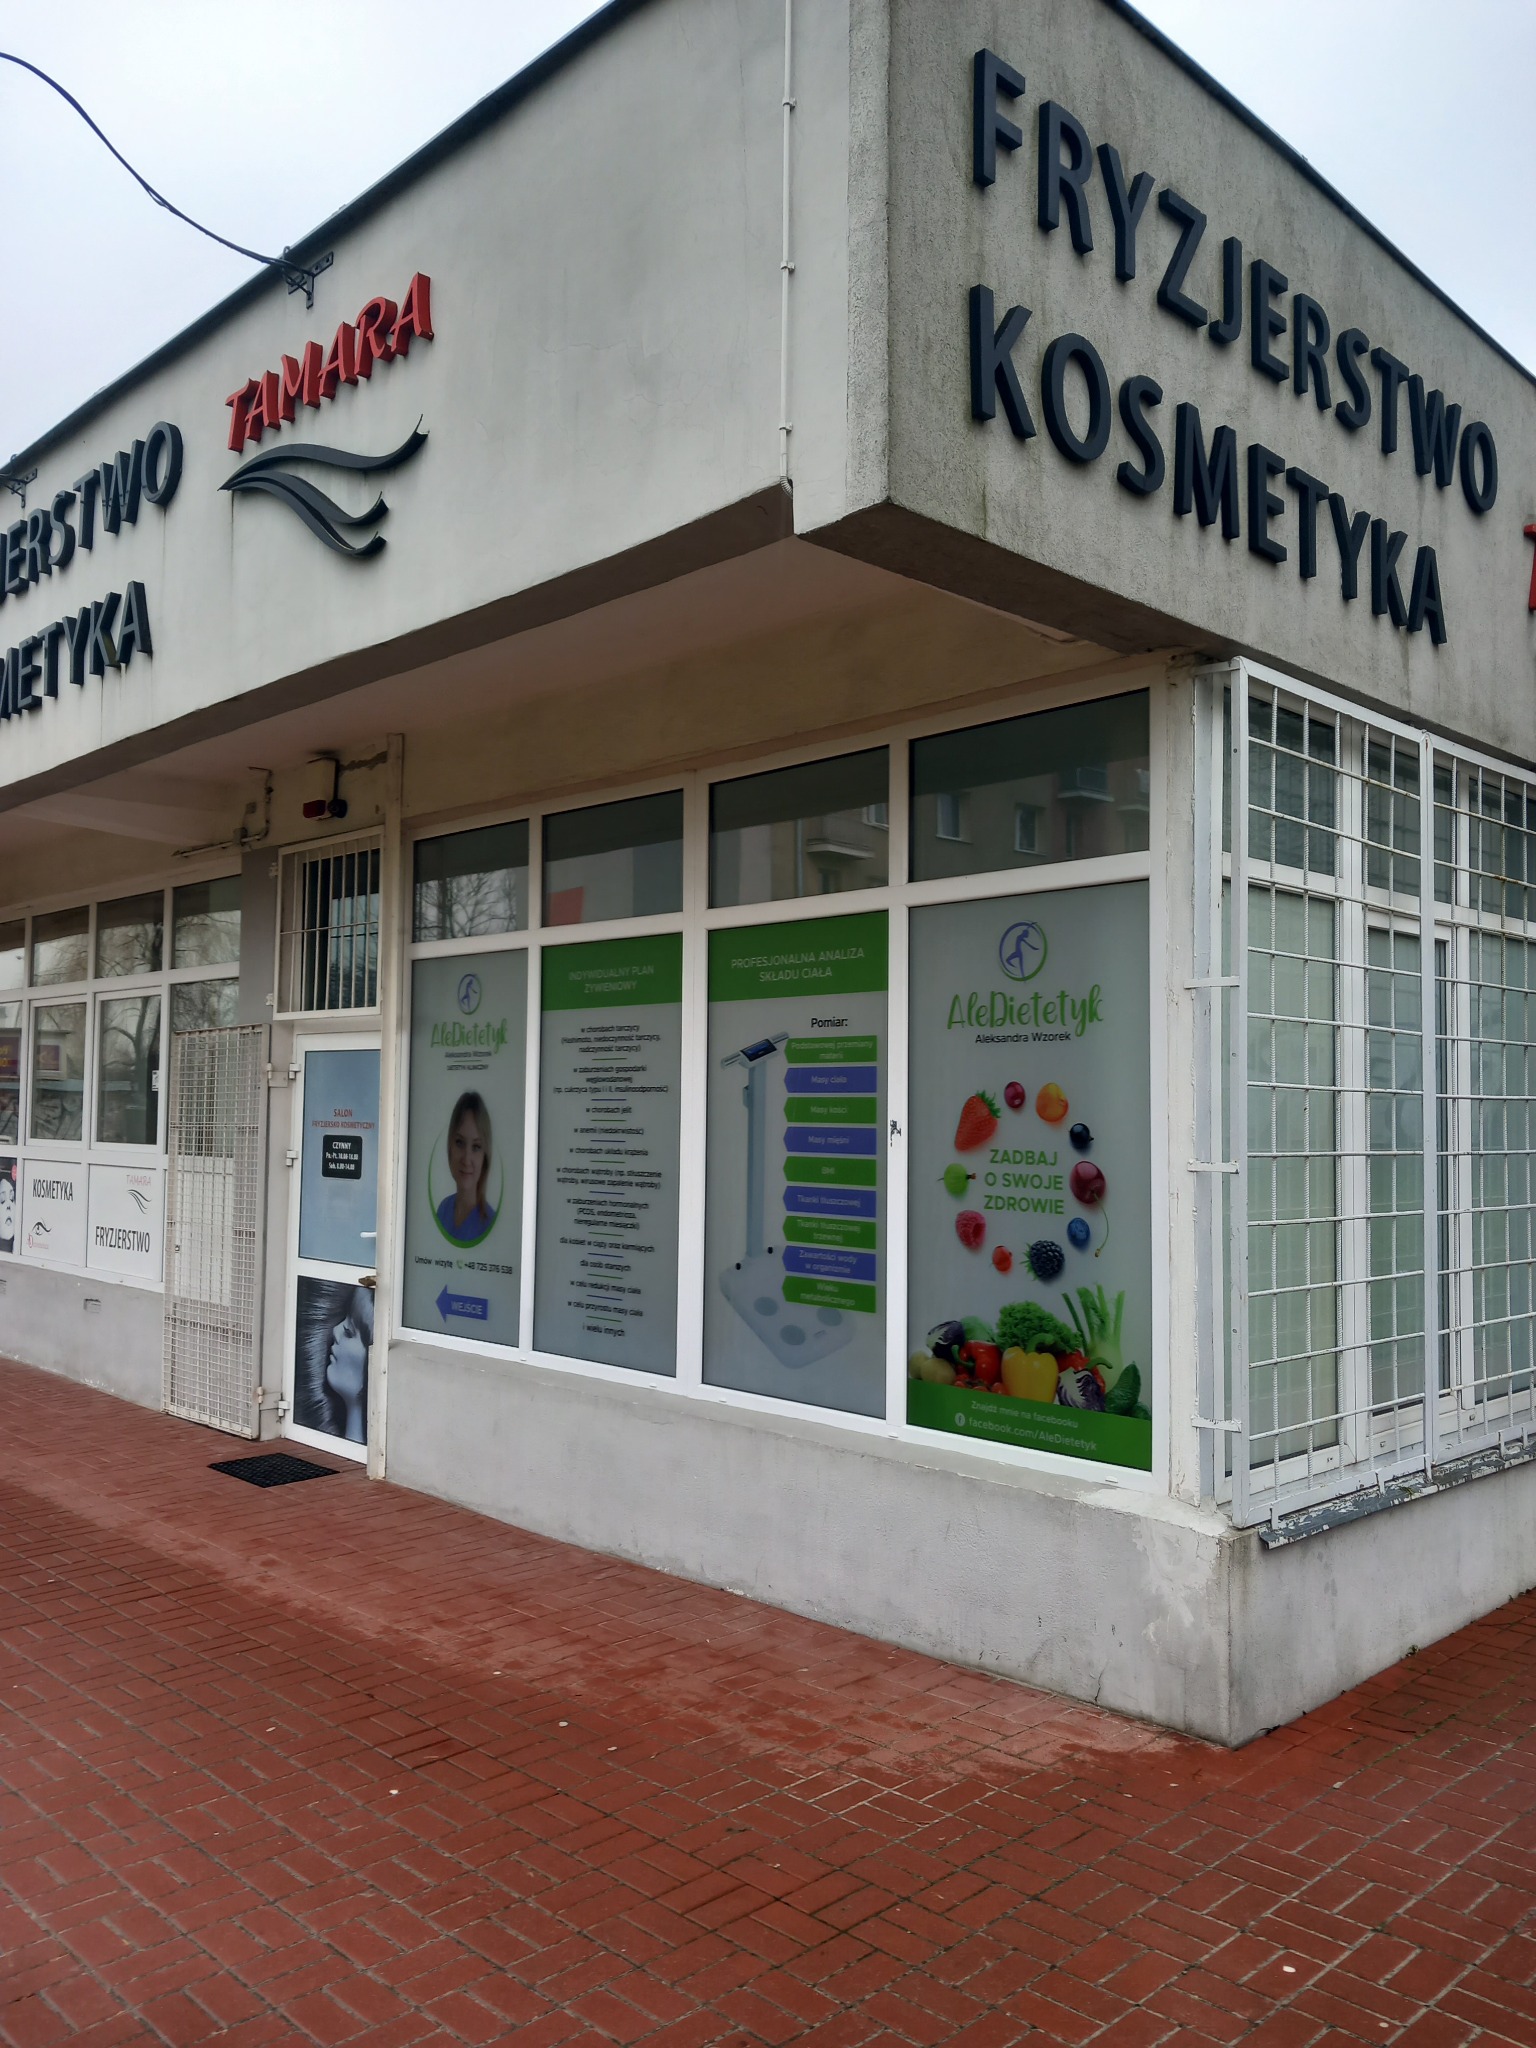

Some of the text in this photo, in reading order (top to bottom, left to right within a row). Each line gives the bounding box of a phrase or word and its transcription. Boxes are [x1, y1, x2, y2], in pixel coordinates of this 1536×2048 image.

[973, 48, 1497, 514] FRYZJERSTWO
[225, 272, 434, 453] TAMARA
[969, 284, 1447, 644] KOSMETYKA
[0, 421, 183, 604] ERSTWO
[732, 948, 864, 968] PROFESJONALNA ANALIZA
[569, 965, 654, 980] INDYWIDUALNY PLAN
[760, 967, 832, 981] SKŁADU CIAŁA
[947, 984, 1104, 1037] AleDietetyk
[811, 1016, 848, 1028] Pomiar:
[430, 1018, 509, 1054] AleDietetyk
[975, 1031, 1071, 1043] Aleksandra Wzorek
[811, 1076, 829, 1084] Masy
[334, 1109, 352, 1117] SALON
[811, 1106, 828, 1115] Masy
[808, 1136, 826, 1144] Masy
[990, 1149, 1058, 1166] ZADBAJ
[126, 1174, 151, 1186] TAMARA
[984, 1172, 1063, 1190] O SWOJE
[33, 1179, 73, 1201] KOSMETYKA
[984, 1195, 1064, 1214] ZDROWIE
[95, 1226, 150, 1253] FRYZJERSTWO
[415, 1256, 432, 1265] Umów
[998, 1407, 1019, 1417] mnie
[1020, 1411, 1032, 1419] na
[1033, 1412, 1079, 1429] facebooku
[969, 1417, 1097, 1451] facebook.com/AleDietetyk
